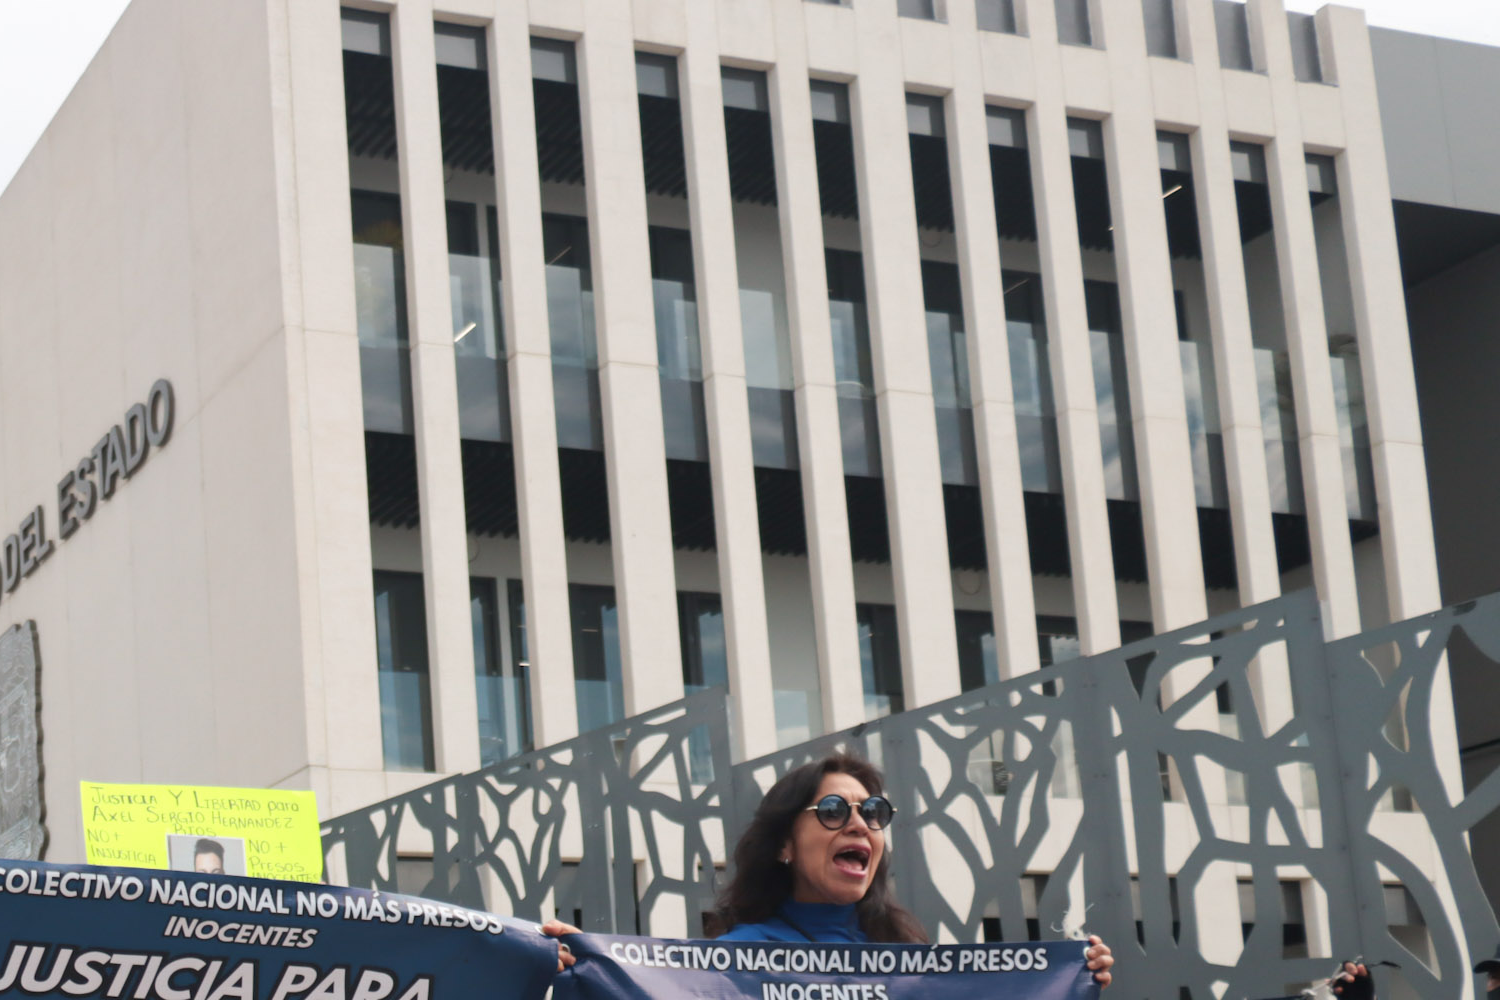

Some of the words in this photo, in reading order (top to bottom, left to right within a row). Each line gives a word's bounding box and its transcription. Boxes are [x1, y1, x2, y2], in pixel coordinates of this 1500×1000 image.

[2, 505, 54, 593] DEL
[57, 378, 175, 540] ESTADO
[169, 790, 182, 806] Y
[87, 828, 110, 843] NO
[248, 839, 270, 854] NO
[91, 846, 157, 865] INJUSTICIA
[148, 878, 290, 915] NACIONAL
[296, 891, 338, 918] NO
[344, 891, 401, 923] MÁS
[407, 903, 504, 934] PRESOS
[164, 916, 318, 948] INOCENTES
[610, 943, 731, 971] COLECTIVO
[736, 948, 854, 974] NACIONAL
[860, 949, 896, 974] NO
[901, 944, 953, 972] MÁS
[958, 947, 1048, 972] PRESOS
